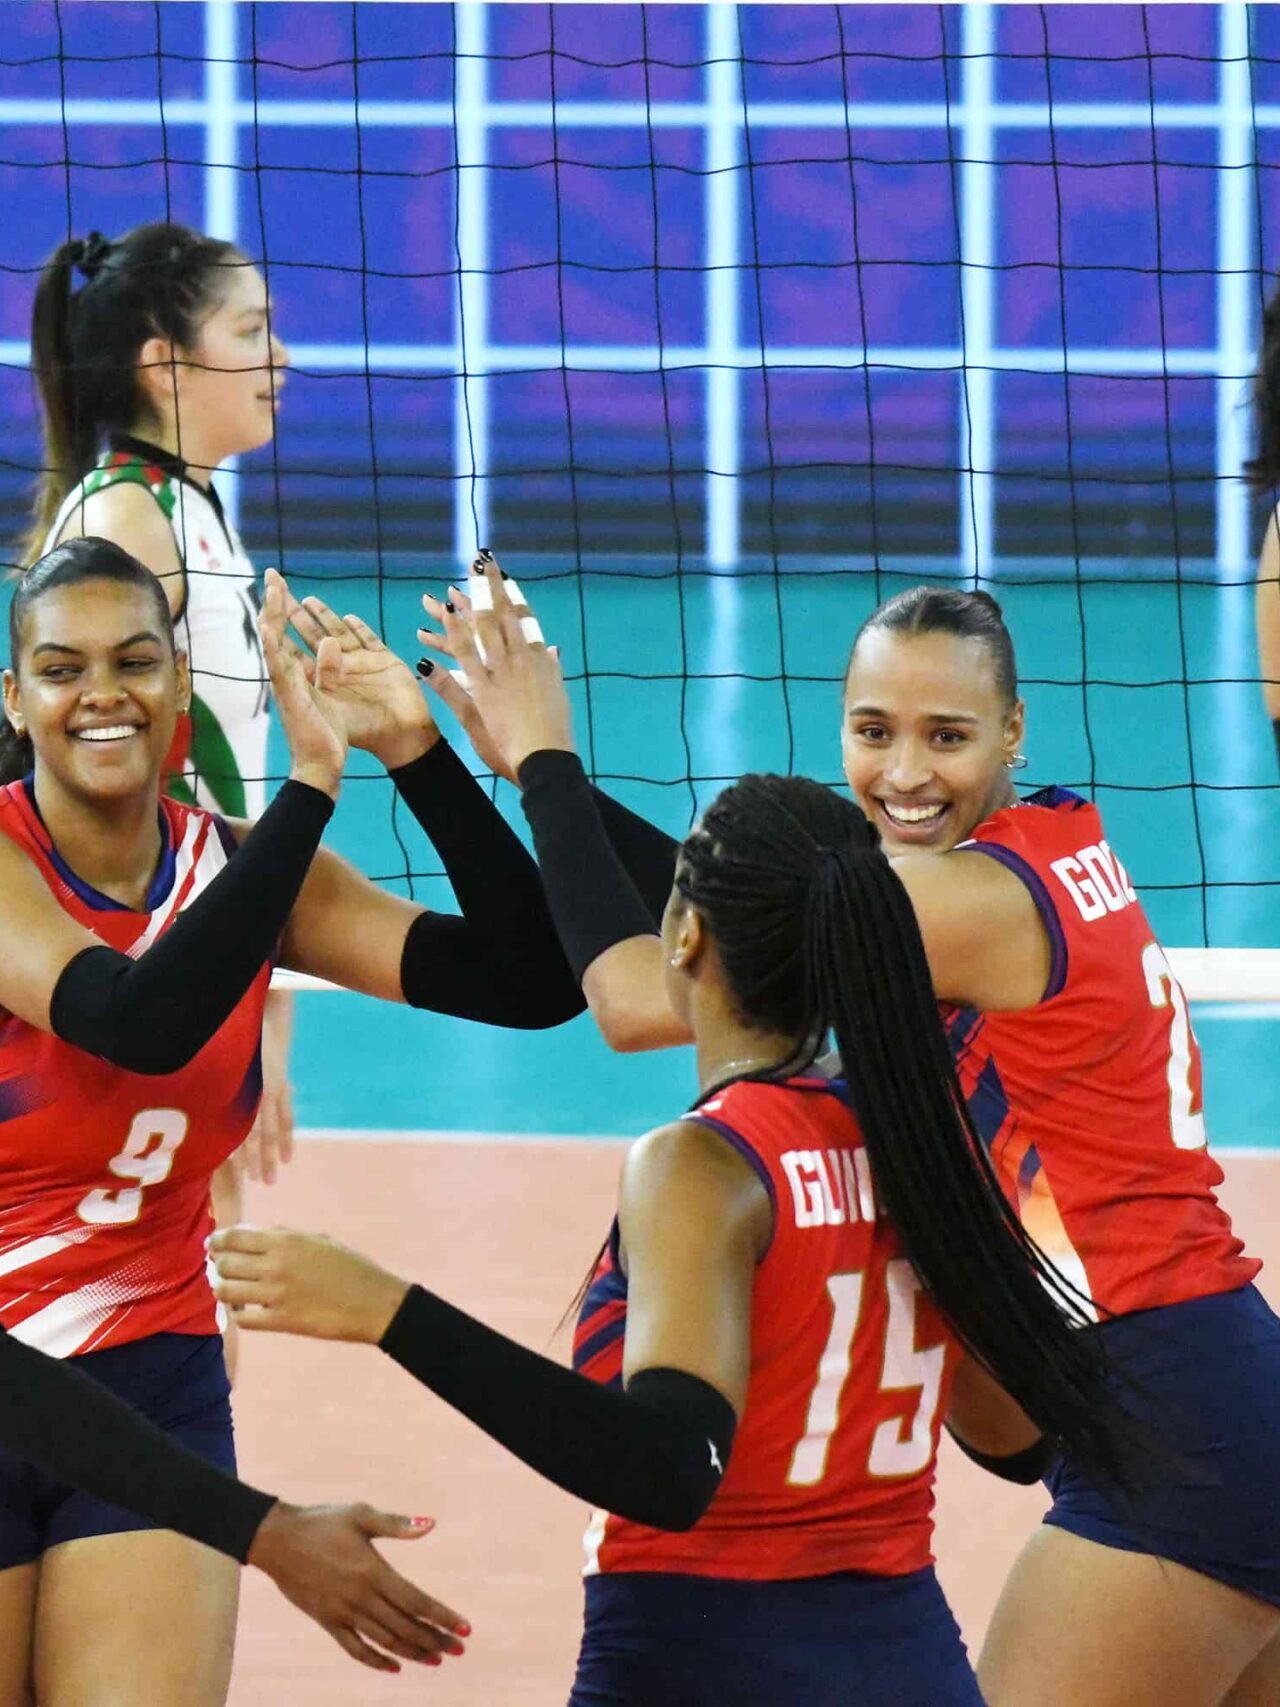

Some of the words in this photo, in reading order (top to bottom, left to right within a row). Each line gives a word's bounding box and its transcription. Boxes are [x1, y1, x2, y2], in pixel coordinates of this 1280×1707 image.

[1141, 939, 1209, 1150] 2
[77, 1107, 189, 1224] 9
[785, 1258, 946, 1487] 15
